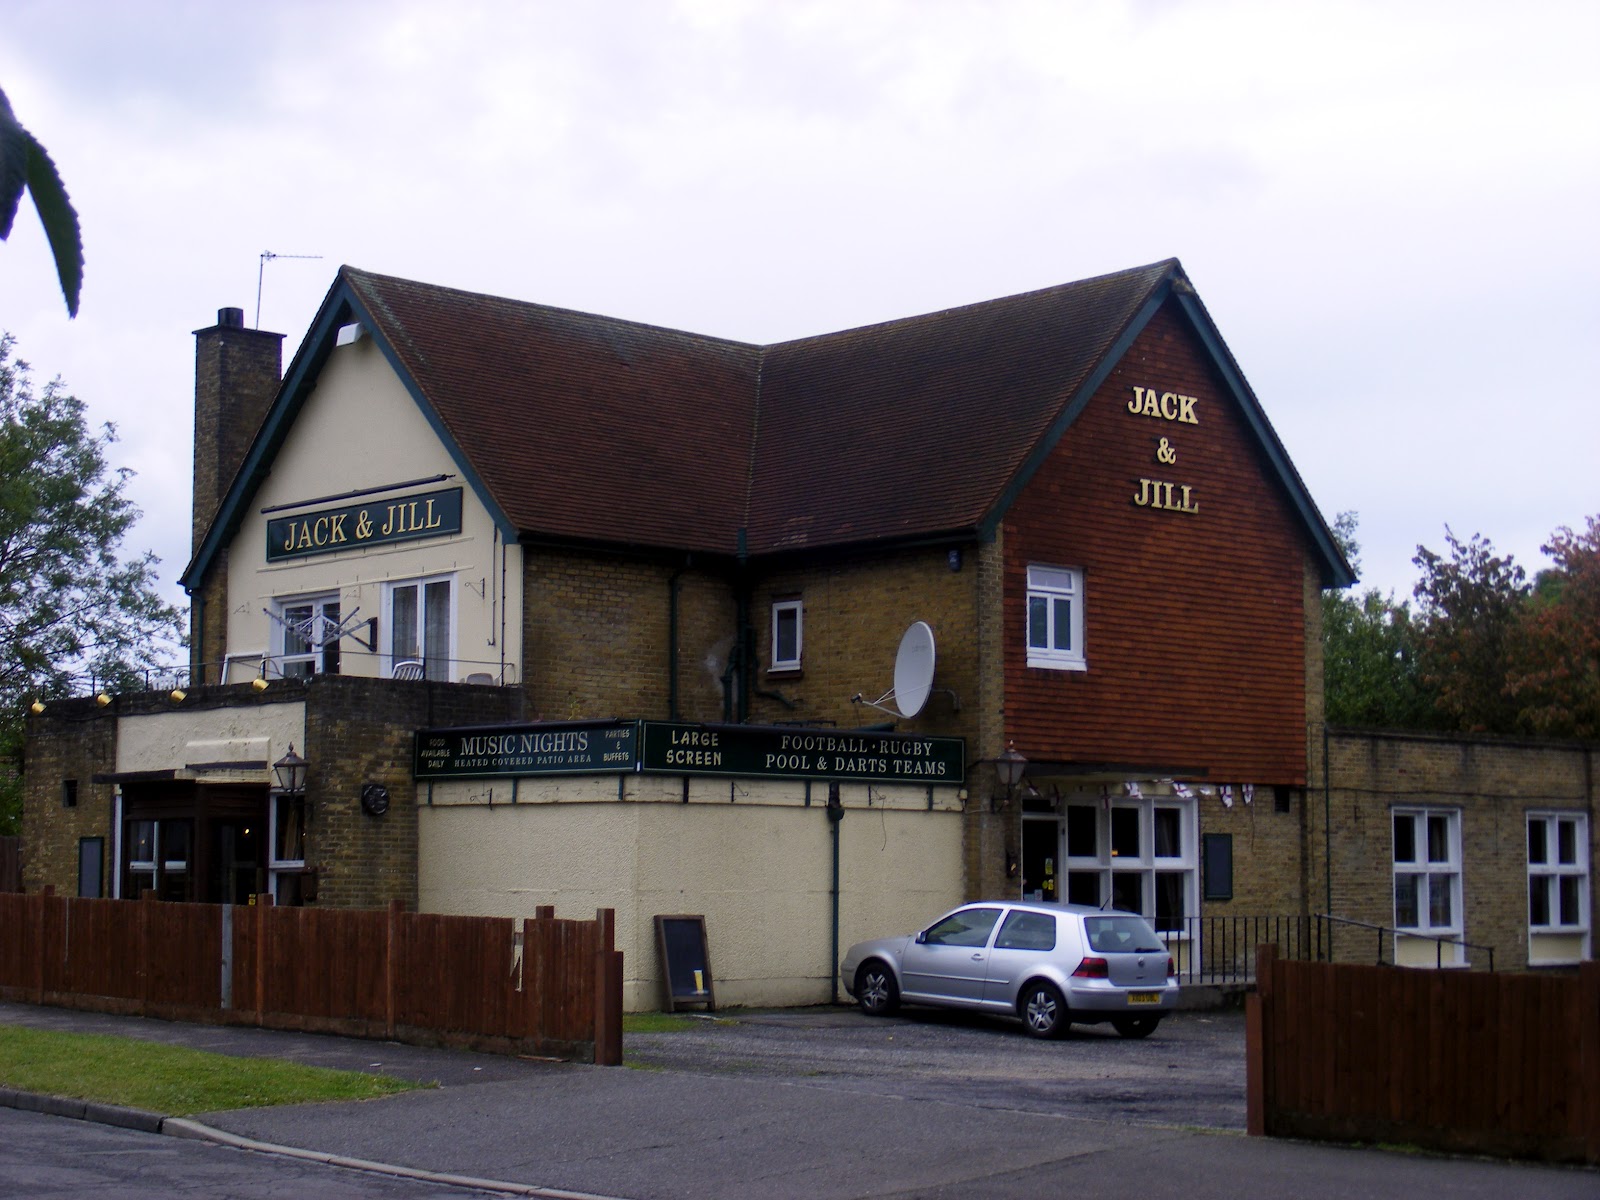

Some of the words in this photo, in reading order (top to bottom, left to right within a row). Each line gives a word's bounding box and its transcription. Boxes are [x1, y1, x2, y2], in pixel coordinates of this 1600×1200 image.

[1127, 386, 1199, 425] JACK
[1157, 437, 1176, 465] &
[1134, 478, 1199, 514] JILL
[284, 513, 348, 551] JACK
[355, 510, 374, 540] &
[382, 499, 442, 536] JILL
[460, 735, 516, 756] MUSIC
[520, 731, 589, 753] NIGHTS
[604, 729, 630, 739] PARTIES
[671, 730, 719, 747] LARGE
[428, 760, 445, 769] DAILY
[454, 758, 488, 768] HEATED
[491, 757, 533, 767] COVERED
[536, 755, 564, 765] PATIO
[567, 754, 592, 763] AREA
[603, 752, 630, 762] BUFFETS
[666, 750, 722, 766] SCREEN
[765, 753, 810, 770] POOL
[816, 756, 828, 771] &
[835, 756, 887, 773] DARTS
[893, 759, 946, 775] TEAMS
